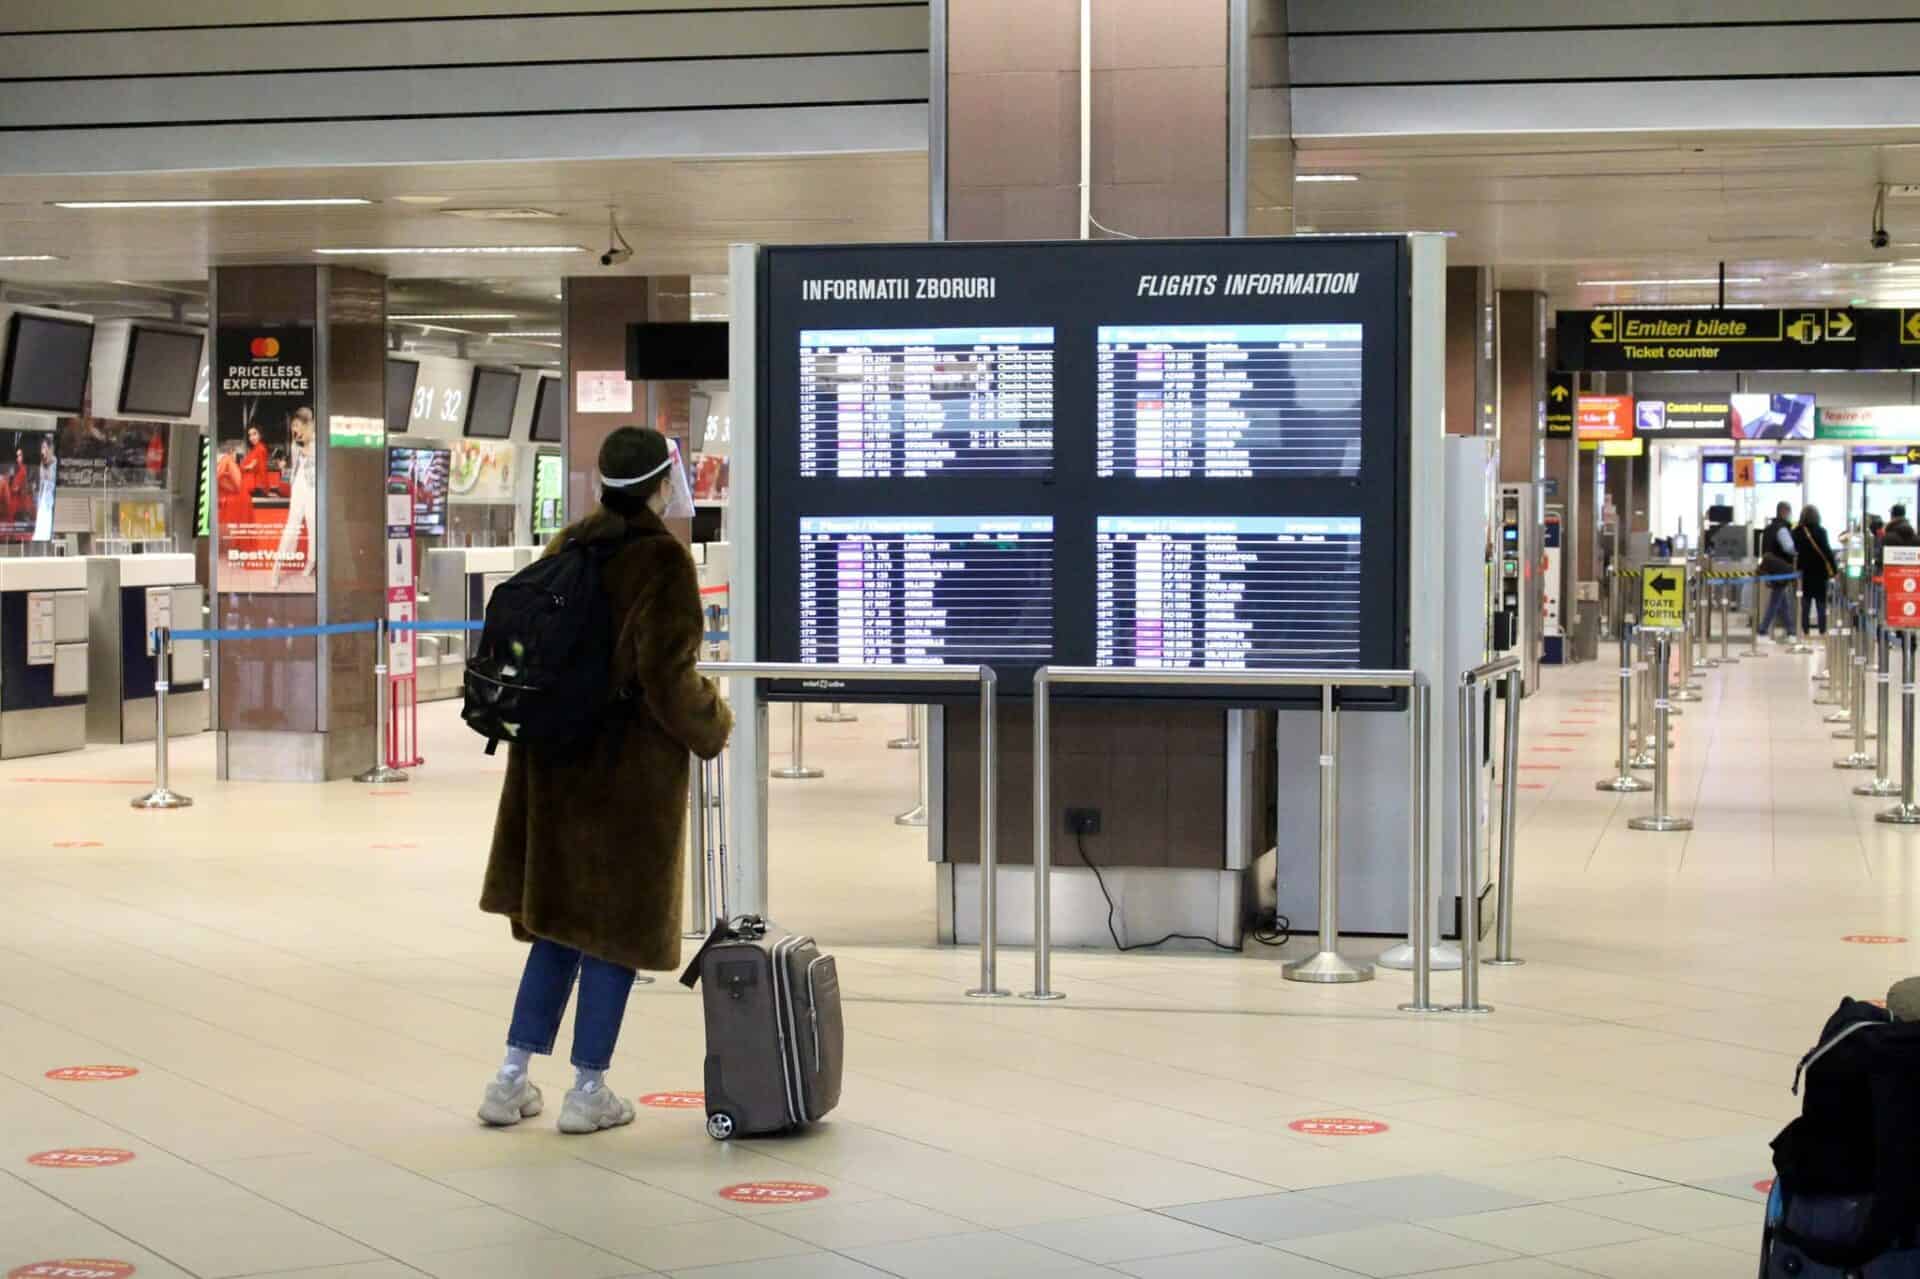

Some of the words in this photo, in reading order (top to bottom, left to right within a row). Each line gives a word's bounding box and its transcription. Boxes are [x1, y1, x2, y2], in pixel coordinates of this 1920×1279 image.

[802, 278, 910, 301] INFORMATII
[915, 277, 996, 299] ZBORURI
[1137, 275, 1217, 297] FLIGHTS
[1224, 273, 1359, 296] INFORMATION
[1625, 318, 1691, 337] Emiteri
[1695, 319, 1748, 337] bilete
[1624, 345, 1665, 359] Ticket
[1668, 346, 1719, 359] counter
[229, 365, 302, 377] PRICELESS
[223, 378, 309, 390] EXPERIENCE
[414, 385, 434, 419] 31
[440, 388, 463, 422] 32
[63, 1069, 125, 1078] STOP
[652, 1094, 705, 1104] STO
[45, 1153, 119, 1163] STOP
[733, 1187, 815, 1198] STOP
[30, 1266, 116, 1279] STOP
